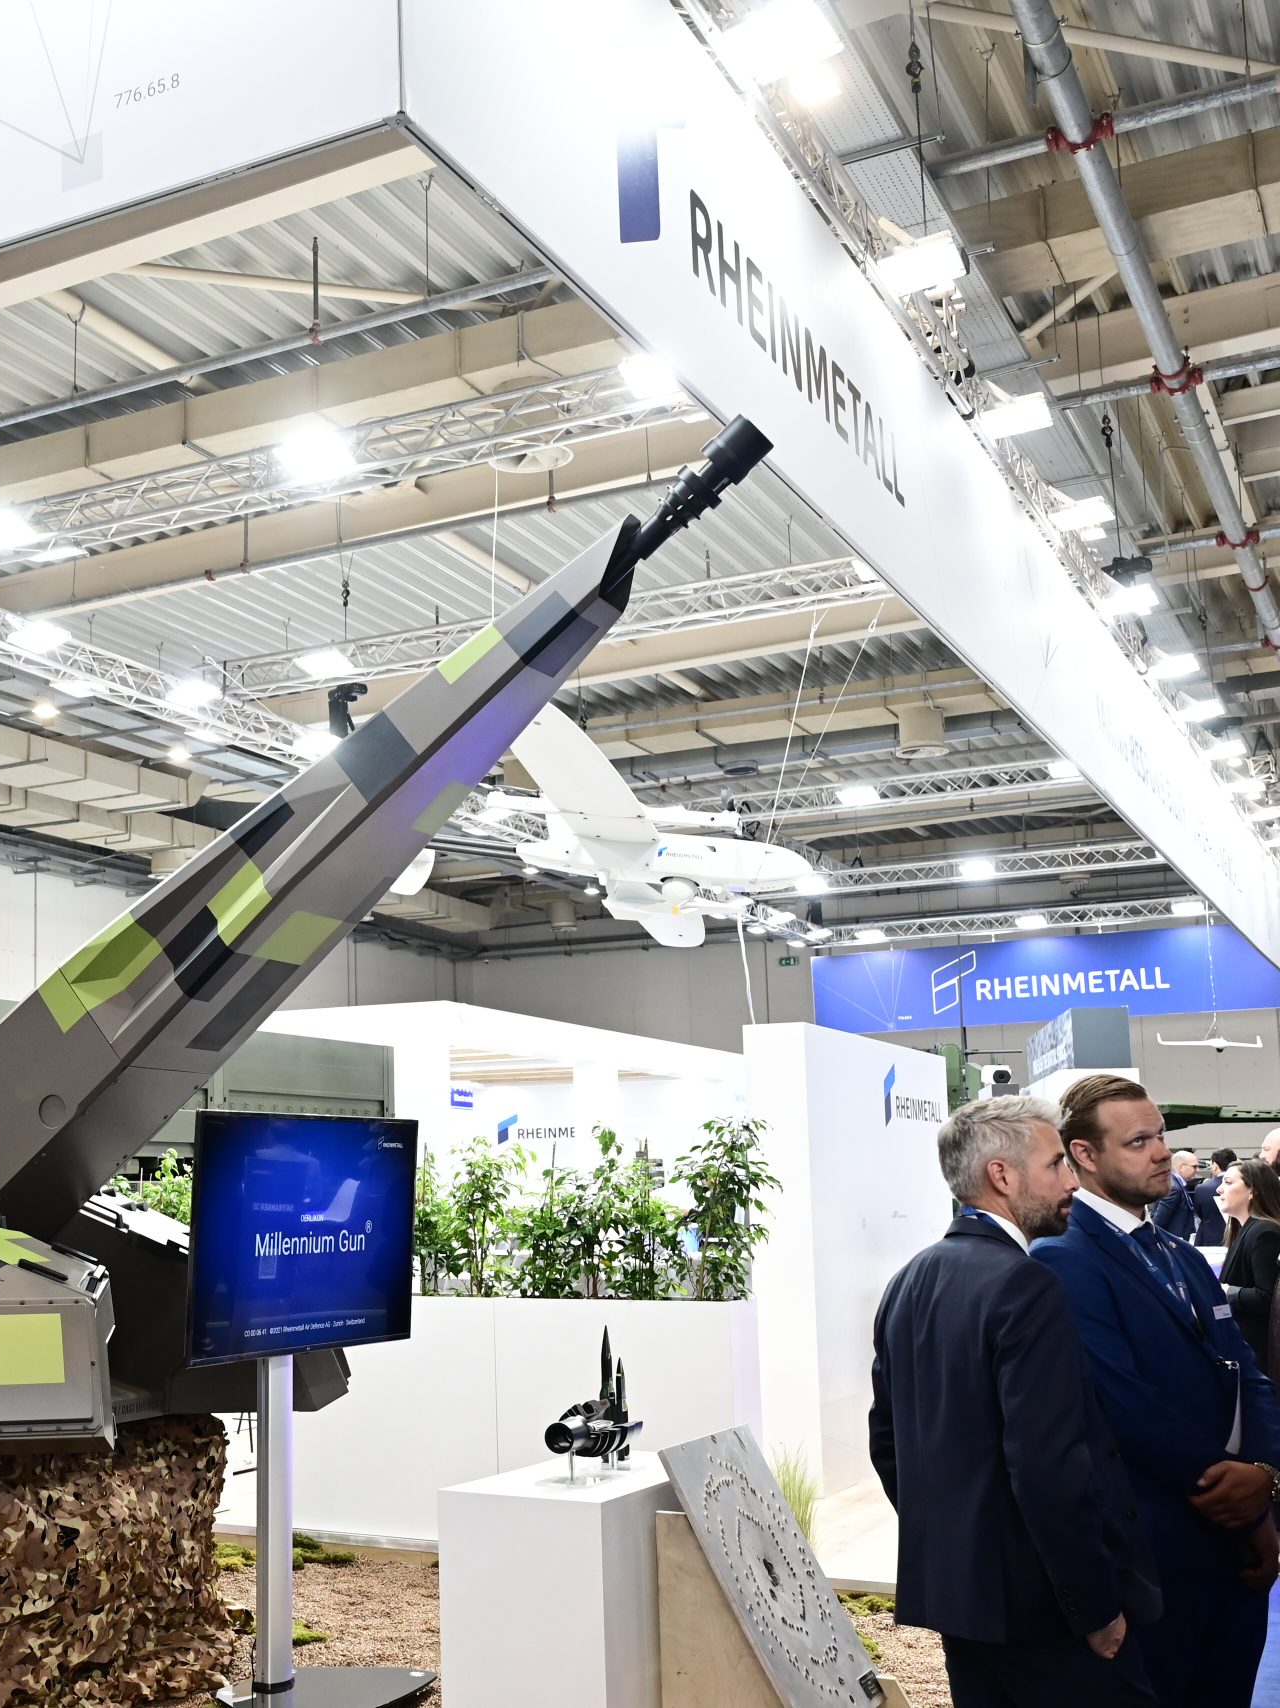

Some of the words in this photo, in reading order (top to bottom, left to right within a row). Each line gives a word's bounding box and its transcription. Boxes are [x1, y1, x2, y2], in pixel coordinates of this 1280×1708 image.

[114, 73, 180, 109] 776.65.8
[689, 188, 906, 508] RHEINMETALL
[975, 966, 1171, 1001] RHEINMETALL
[895, 1094, 943, 1124] RHEINMETALL
[517, 1126, 576, 1140] RHEINME
[254, 1231, 335, 1257] Millennium
